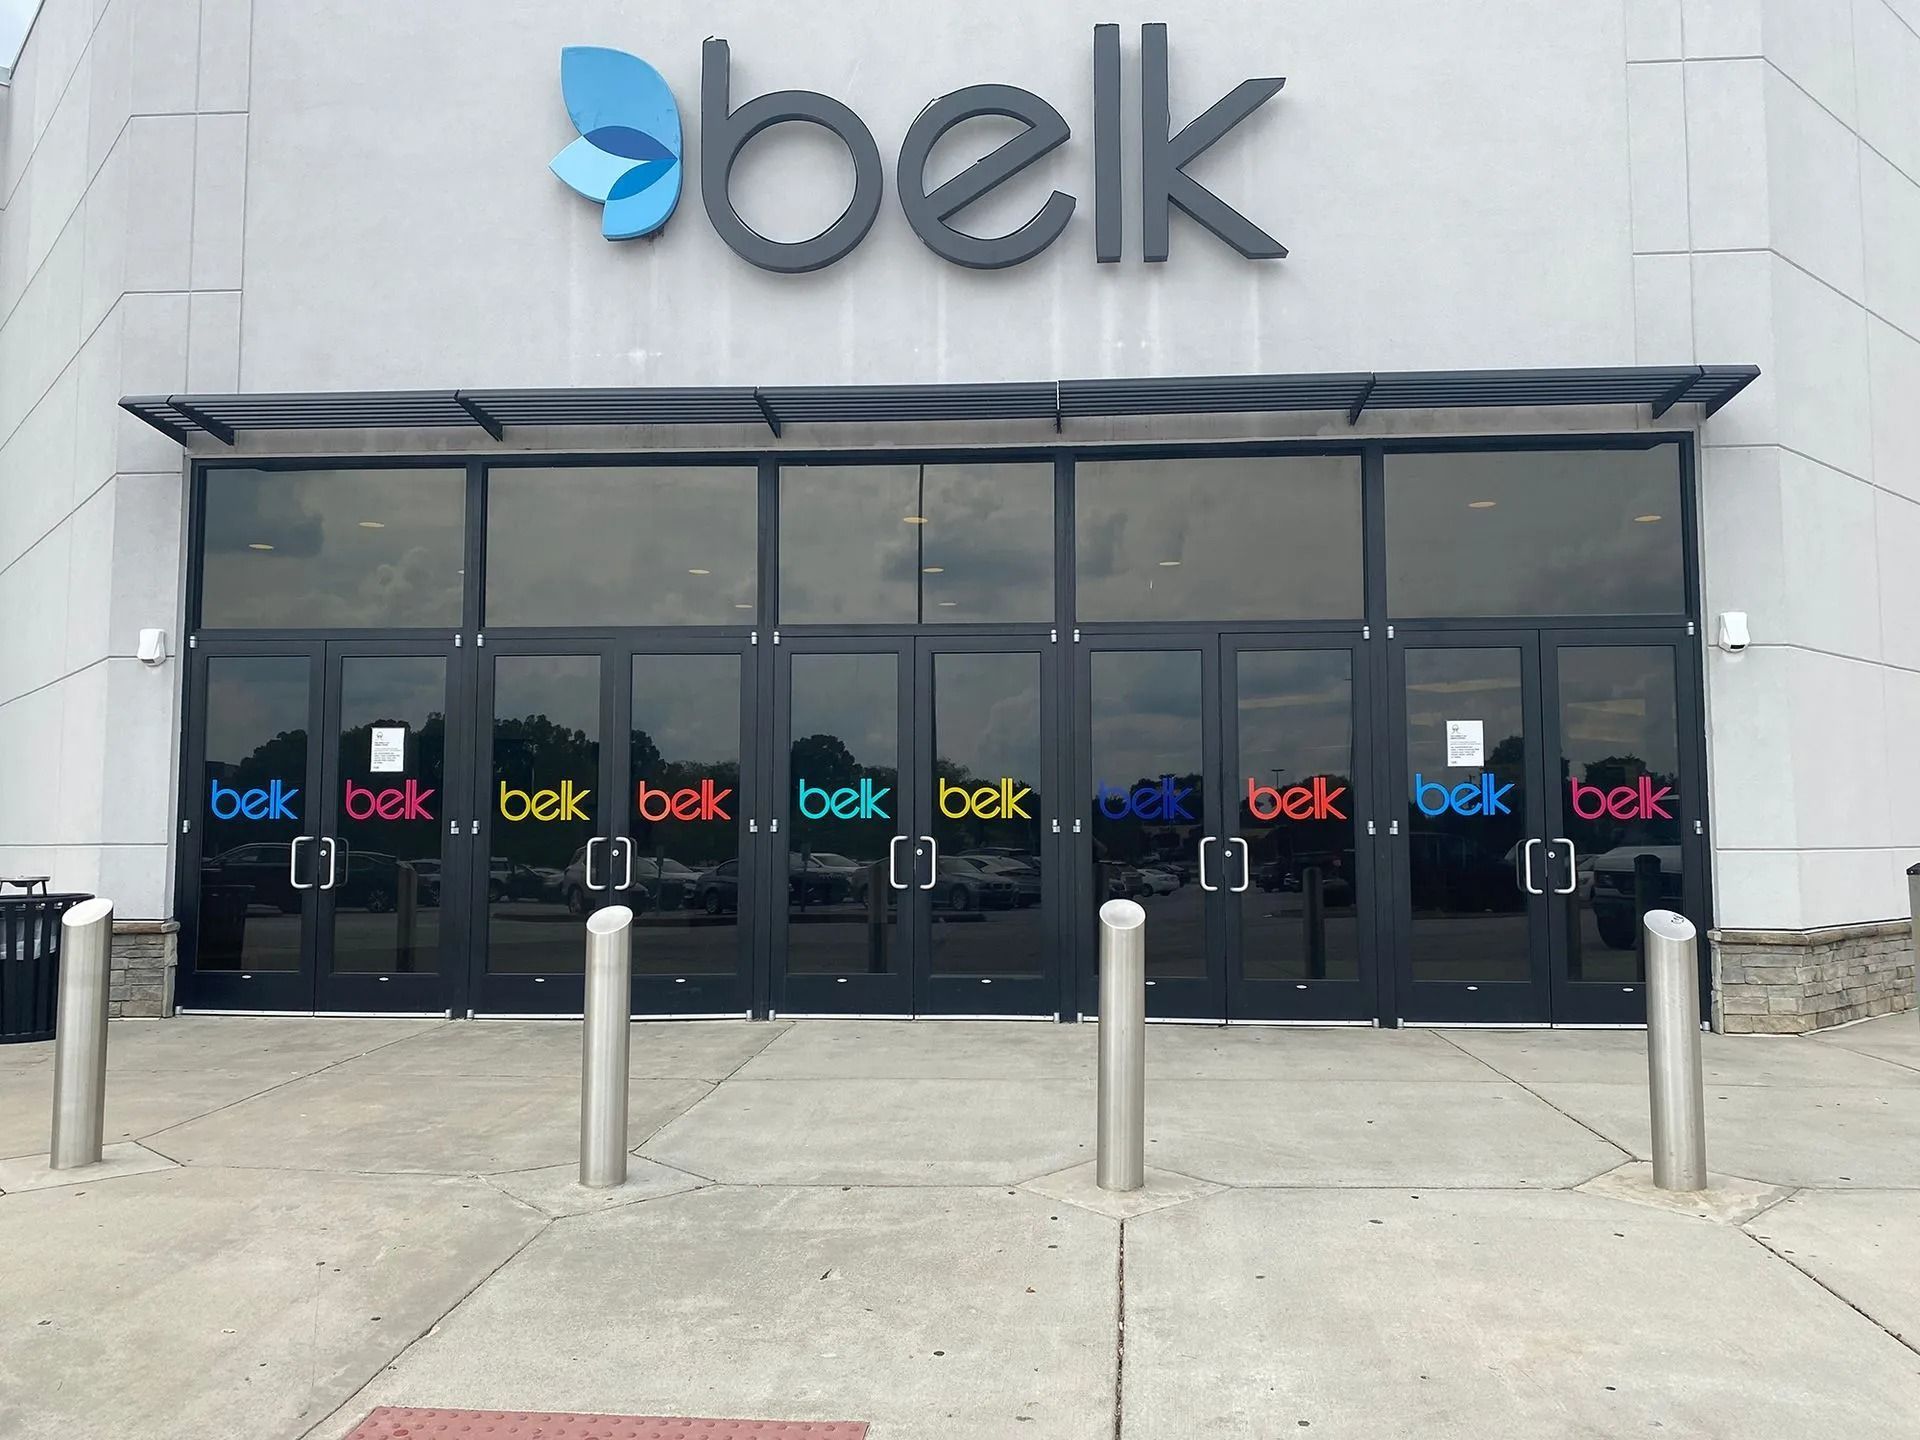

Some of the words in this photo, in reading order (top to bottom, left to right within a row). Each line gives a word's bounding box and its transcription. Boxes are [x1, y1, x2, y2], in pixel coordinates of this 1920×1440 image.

[701, 22, 1288, 273] belk
[211, 779, 299, 821] belk
[345, 779, 434, 821] belk
[499, 780, 591, 821] belk
[638, 778, 732, 821] belk
[798, 778, 891, 820] belk
[938, 777, 1032, 820] belk
[1098, 776, 1195, 820] belk
[1247, 776, 1348, 820] belk
[1415, 772, 1516, 817] belk
[1571, 775, 1673, 820] belk
